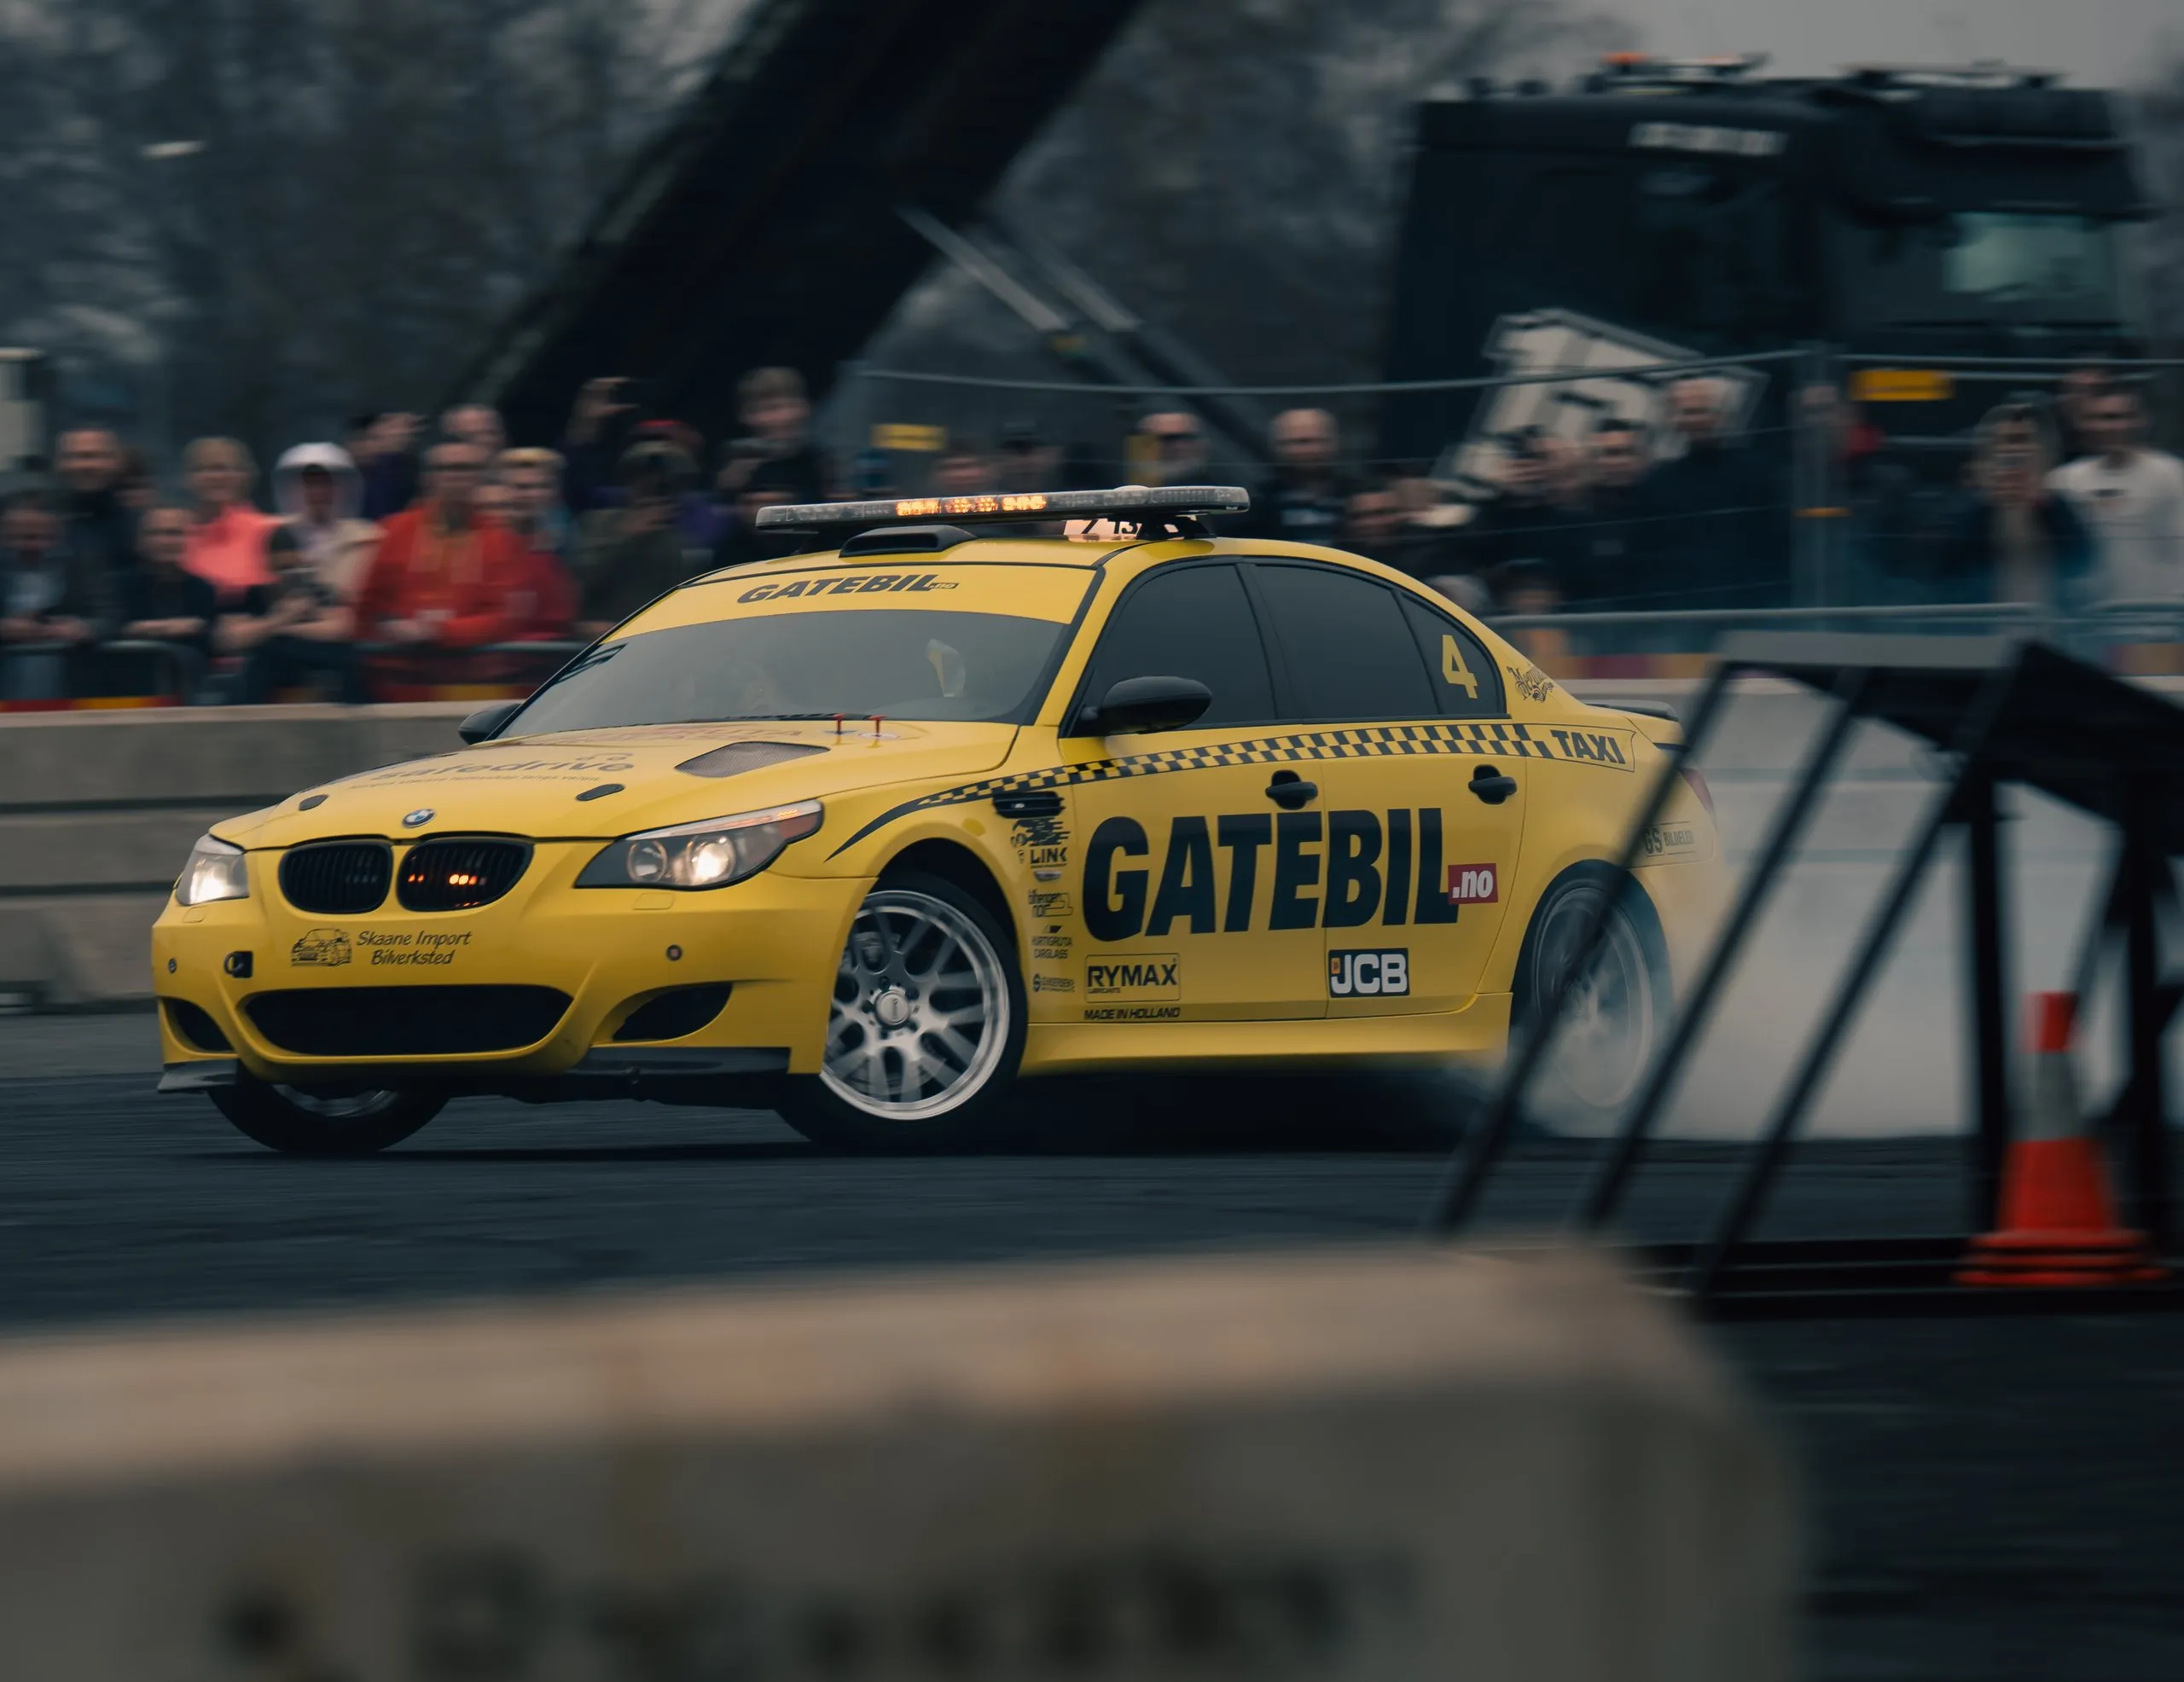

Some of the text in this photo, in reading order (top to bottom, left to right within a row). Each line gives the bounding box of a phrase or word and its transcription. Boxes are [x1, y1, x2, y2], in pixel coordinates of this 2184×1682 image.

[737, 574, 938, 604] GATEBIL
[1442, 635, 1478, 699] 4
[1550, 729, 1626, 764] TAXI
[1082, 807, 1494, 942] GATEBIL .no
[356, 930, 473, 948] Skaane Import
[370, 949, 456, 965] Bilverksted
[1087, 963, 1177, 987] RYMAX
[1331, 954, 1408, 994] JCB
[1084, 1006, 1181, 1020] MADE IN HOLLAND
